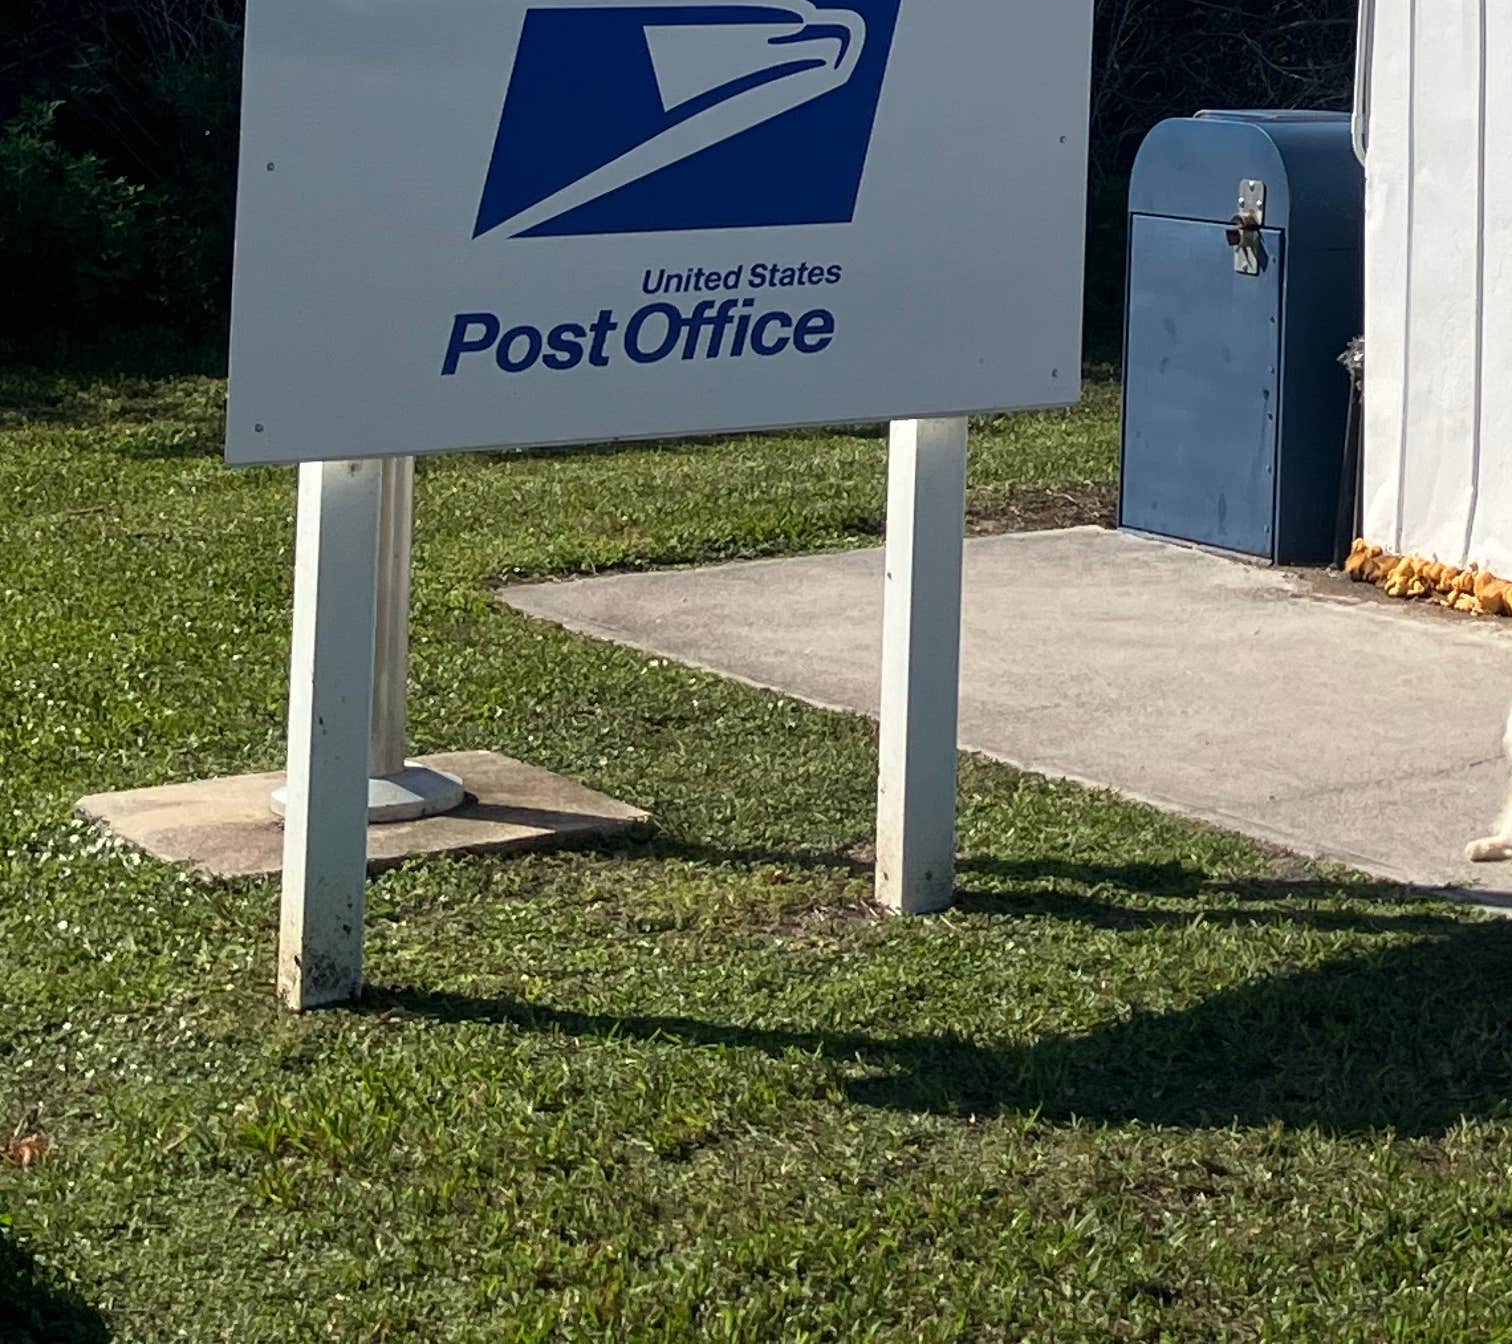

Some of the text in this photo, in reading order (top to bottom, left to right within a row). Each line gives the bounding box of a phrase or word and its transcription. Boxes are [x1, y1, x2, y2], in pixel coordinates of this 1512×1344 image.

[641, 262, 842, 295] United States
[440, 297, 836, 377] Post Office
